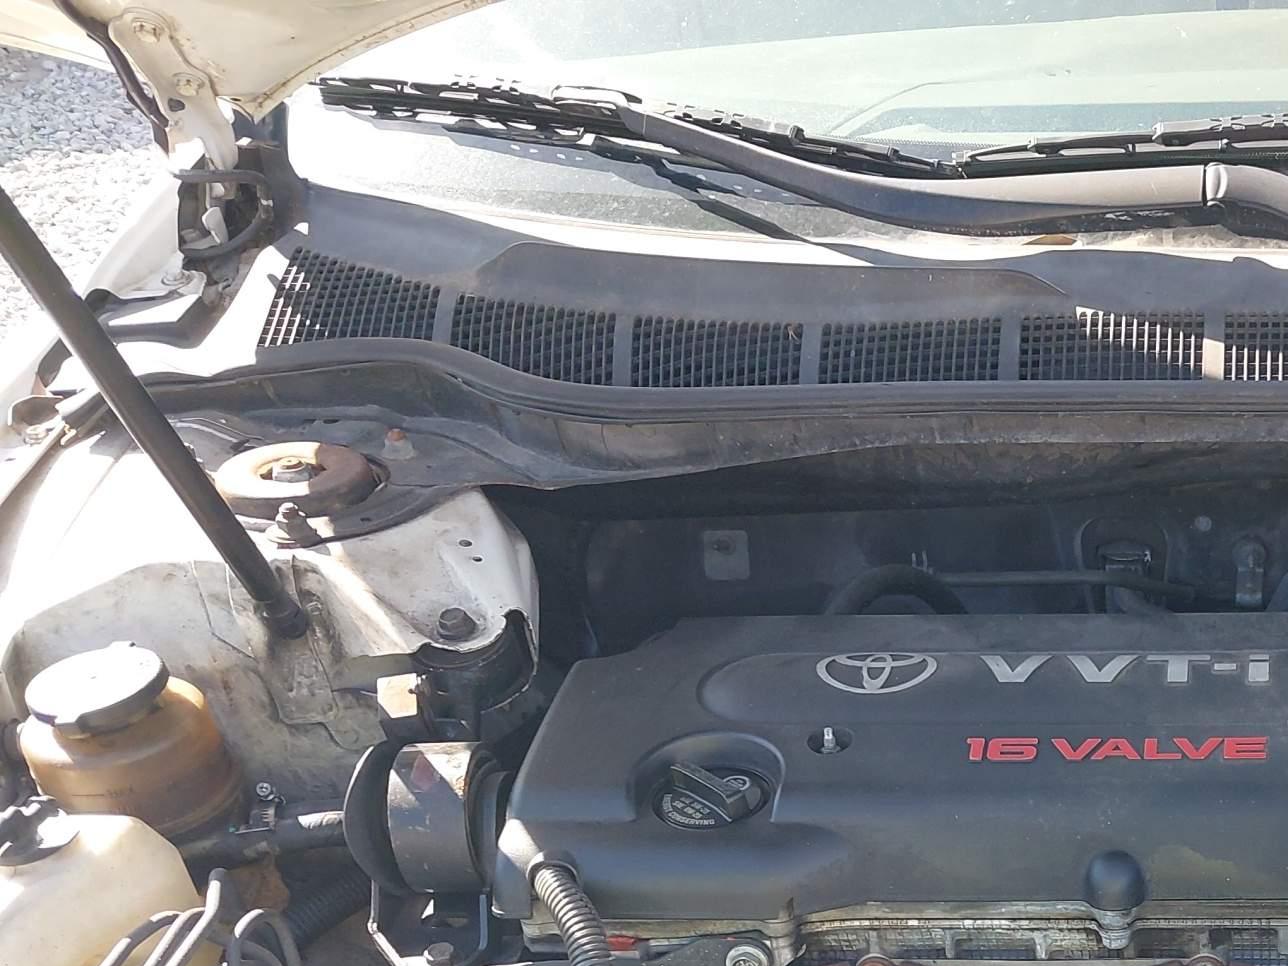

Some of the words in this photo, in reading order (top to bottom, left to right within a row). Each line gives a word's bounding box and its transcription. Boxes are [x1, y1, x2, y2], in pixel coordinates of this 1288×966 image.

[980, 655, 1272, 684] VVT-i
[966, 736, 1039, 761] 16
[1050, 736, 1269, 761] VALVE
